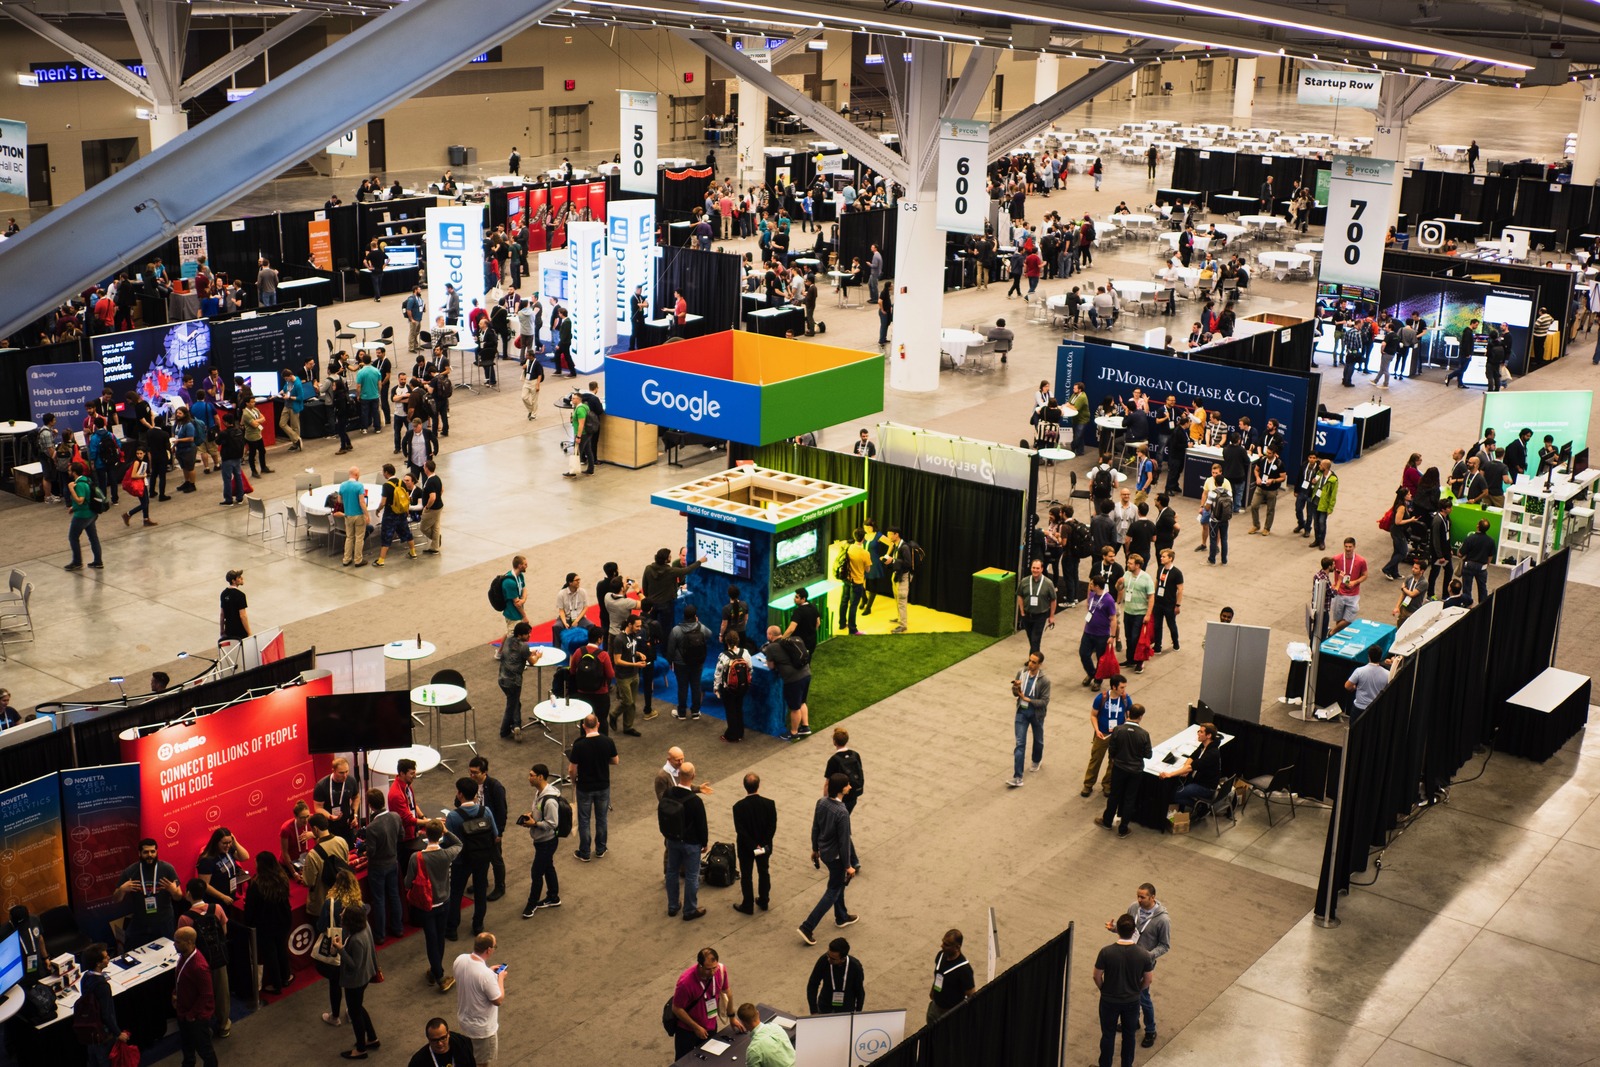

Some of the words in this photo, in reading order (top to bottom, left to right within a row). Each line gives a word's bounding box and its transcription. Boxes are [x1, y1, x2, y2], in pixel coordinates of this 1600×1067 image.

[34, 65, 77, 81] men's
[81, 63, 148, 80] resm
[1304, 77, 1347, 90] Startup
[1349, 80, 1374, 90] Row
[634, 124, 643, 176] 500
[955, 157, 970, 214] 600
[904, 203, 917, 211] C-5
[1344, 199, 1367, 265] 700
[102, 355, 126, 365] Sentry
[103, 363, 133, 376] provides
[104, 372, 134, 383] answers.
[33, 388, 53, 397] Help
[65, 385, 92, 393] create
[1223, 391, 1237, 402] &
[34, 400, 49, 408] the
[50, 399, 75, 407] future
[77, 396, 86, 404] of
[641, 379, 721, 421] Google
[686, 504, 701, 515] Build
[701, 508, 710, 517] for
[710, 511, 737, 524] everyone
[802, 513, 818, 523] Create
[823, 501, 843, 514] everyone
[173, 735, 206, 754] twilio
[160, 756, 205, 786] CONNECT
[207, 741, 249, 769] BILLIONS
[251, 736, 264, 753] OF
[265, 723, 298, 749] PEOPLE
[74, 775, 105, 784] NOVETTA
[75, 780, 106, 790] CYBER
[85, 784, 118, 795] SIGINT
[161, 783, 188, 804] WITH
[189, 772, 214, 797] CODE
[1, 793, 28, 806] NOVETTA
[1, 798, 29, 813] CYBER
[3, 796, 51, 819] ANALYTICS
[245, 806, 268, 818] Messaging
[167, 840, 180, 848] Voice
